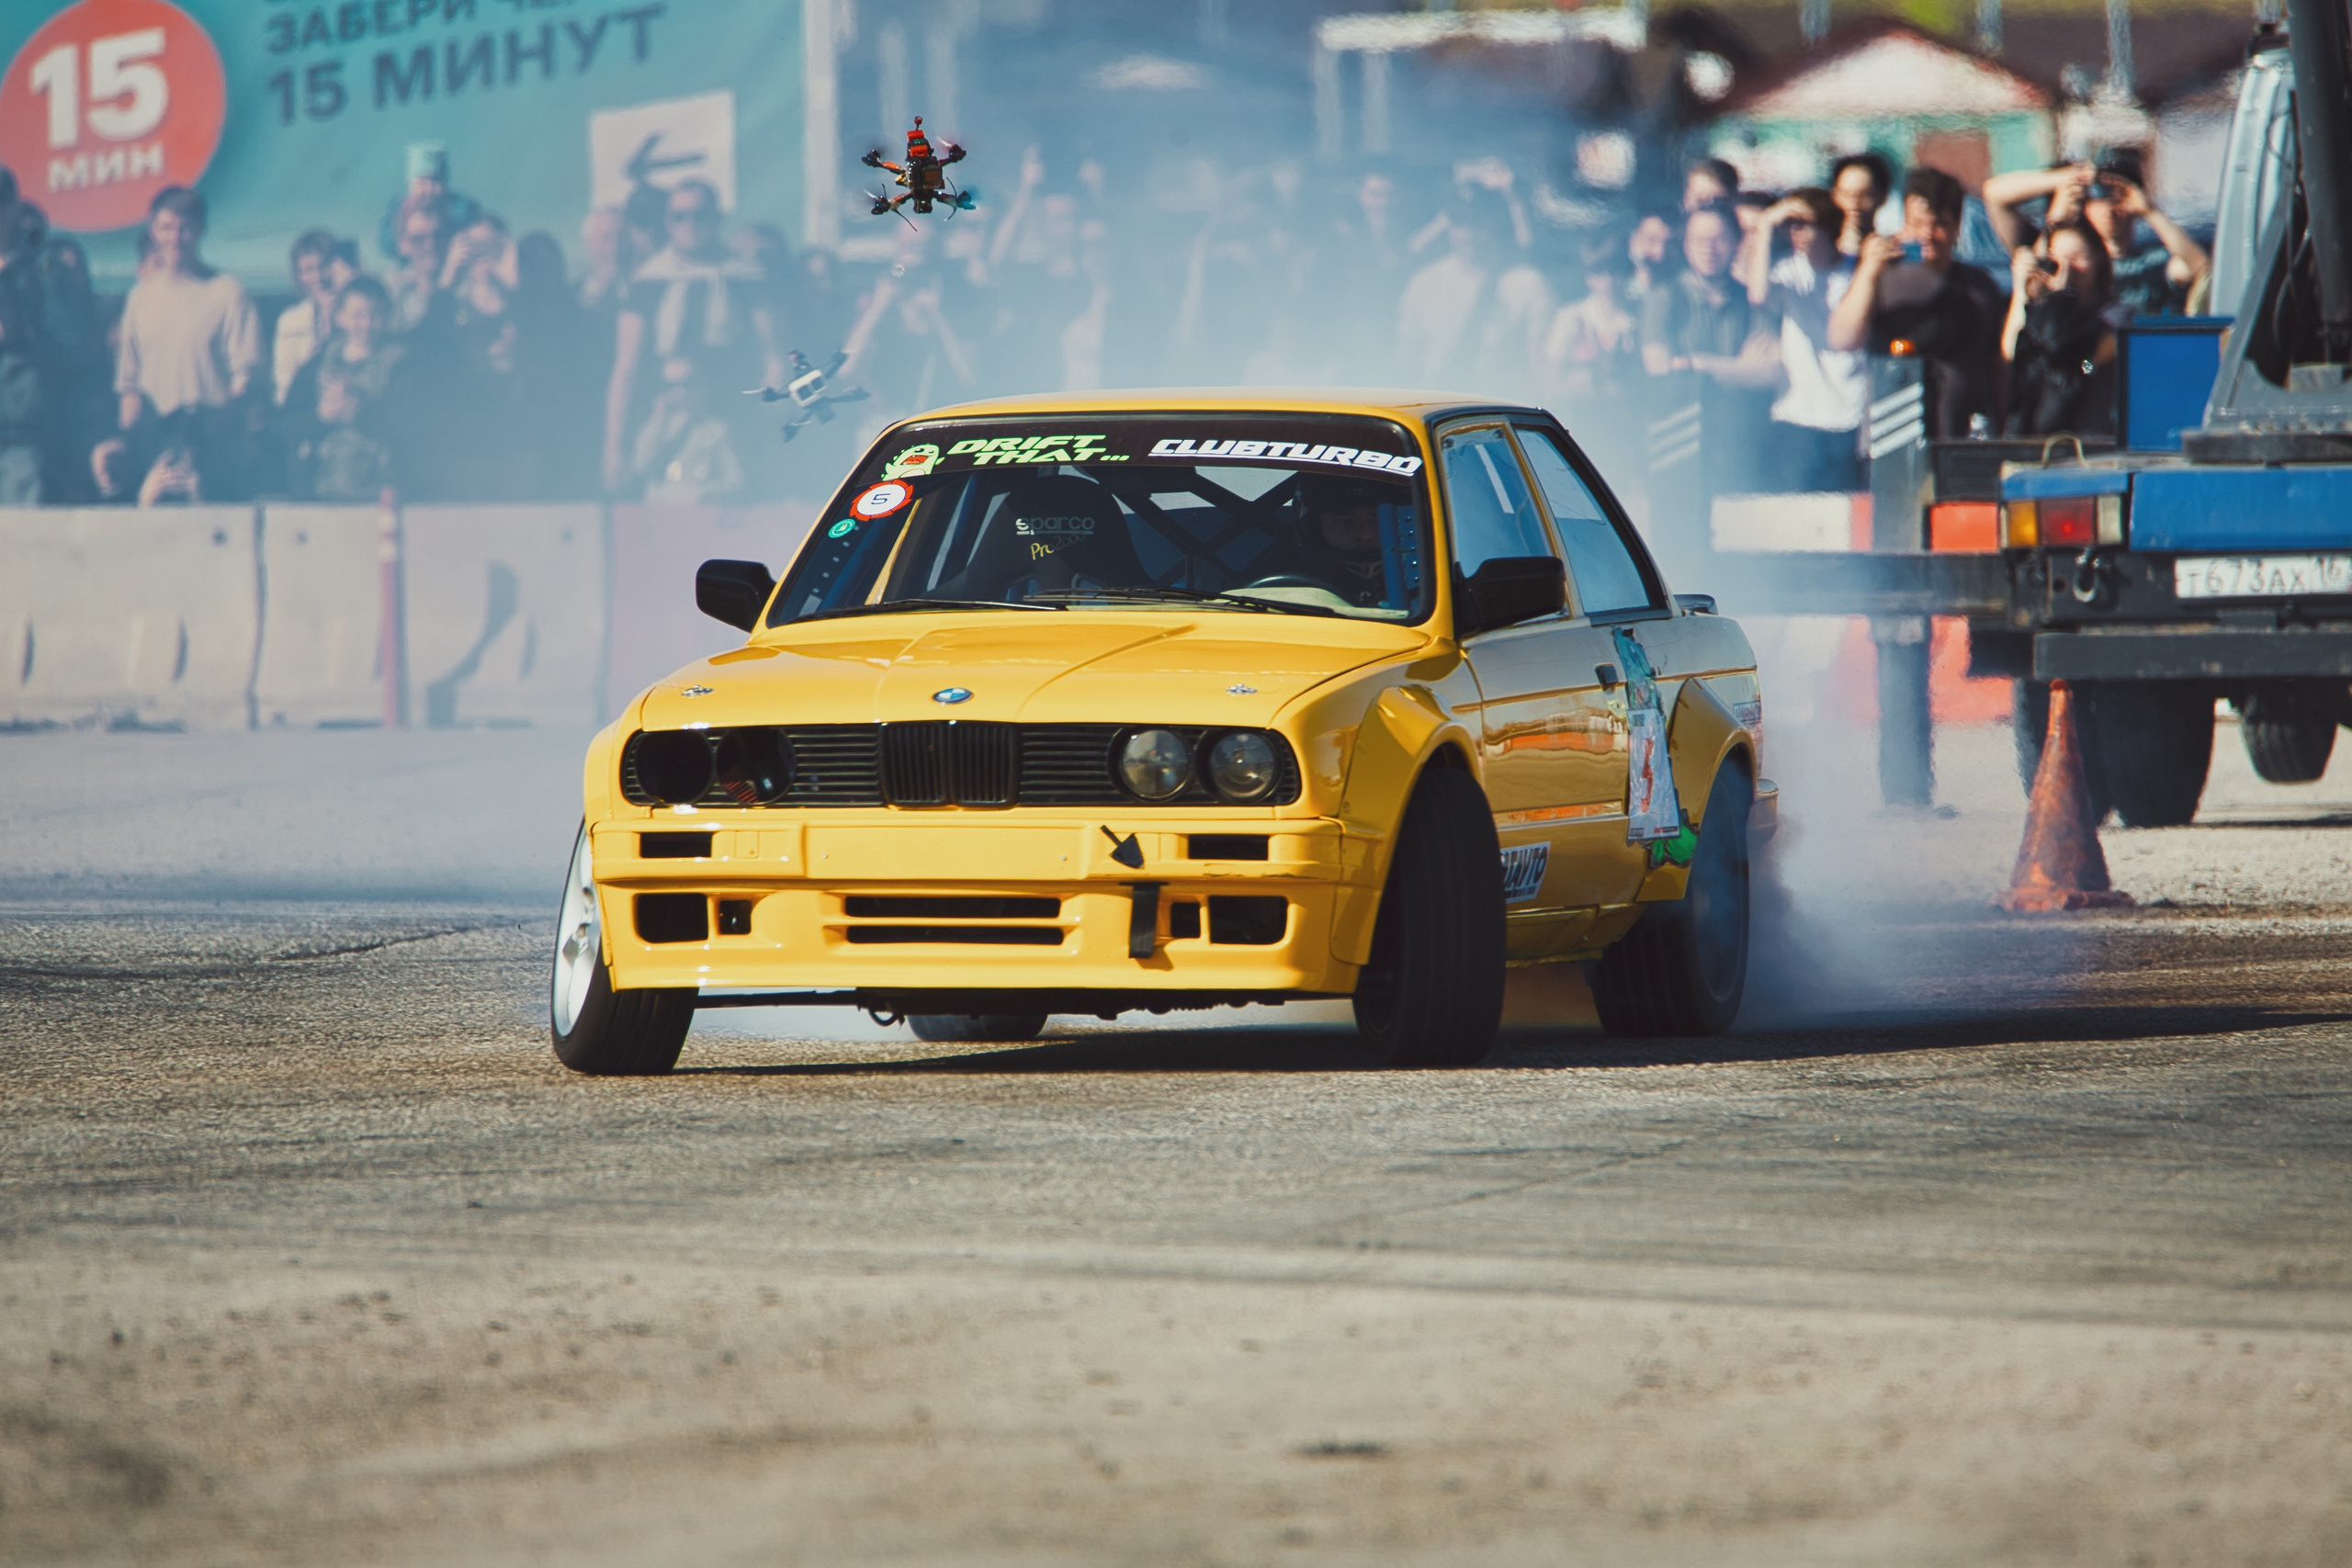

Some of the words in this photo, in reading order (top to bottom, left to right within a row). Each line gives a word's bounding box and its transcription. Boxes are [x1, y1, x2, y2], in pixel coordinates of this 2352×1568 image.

[266, 0, 476, 53] ЗАБЕРИ
[268, 57, 349, 126] 15
[371, 4, 665, 109] МИНУТ
[30, 27, 168, 150] 15
[49, 141, 164, 193] МИН
[946, 434, 1106, 456] DRIFT
[1149, 439, 1423, 475] CLUBTURBO
[871, 492, 891, 505] 5
[1015, 516, 1094, 532] sparco
